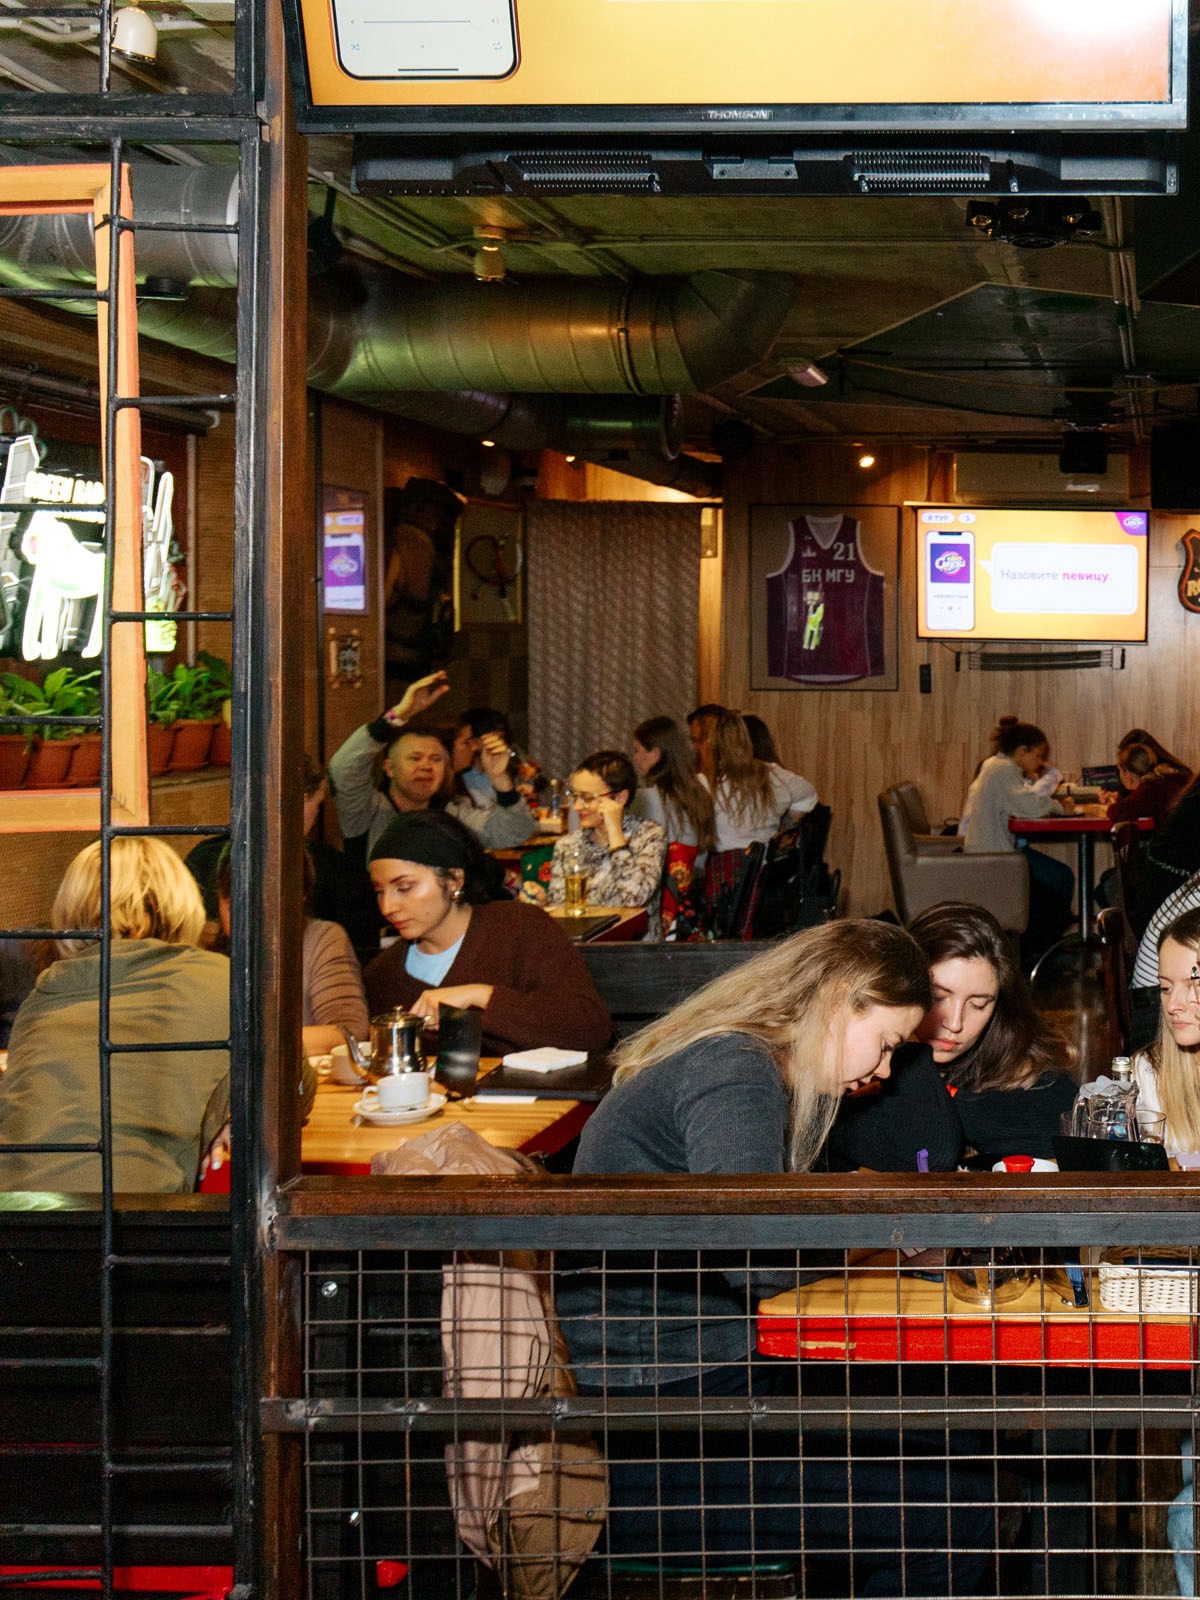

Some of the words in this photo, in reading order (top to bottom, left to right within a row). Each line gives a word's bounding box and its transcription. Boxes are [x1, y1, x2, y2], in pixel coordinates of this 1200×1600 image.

[707, 109, 769, 120] THOMSON
[832, 542, 857, 561] 21
[825, 568, 855, 583] МГУ
[1000, 569, 1059, 581] Назовите
